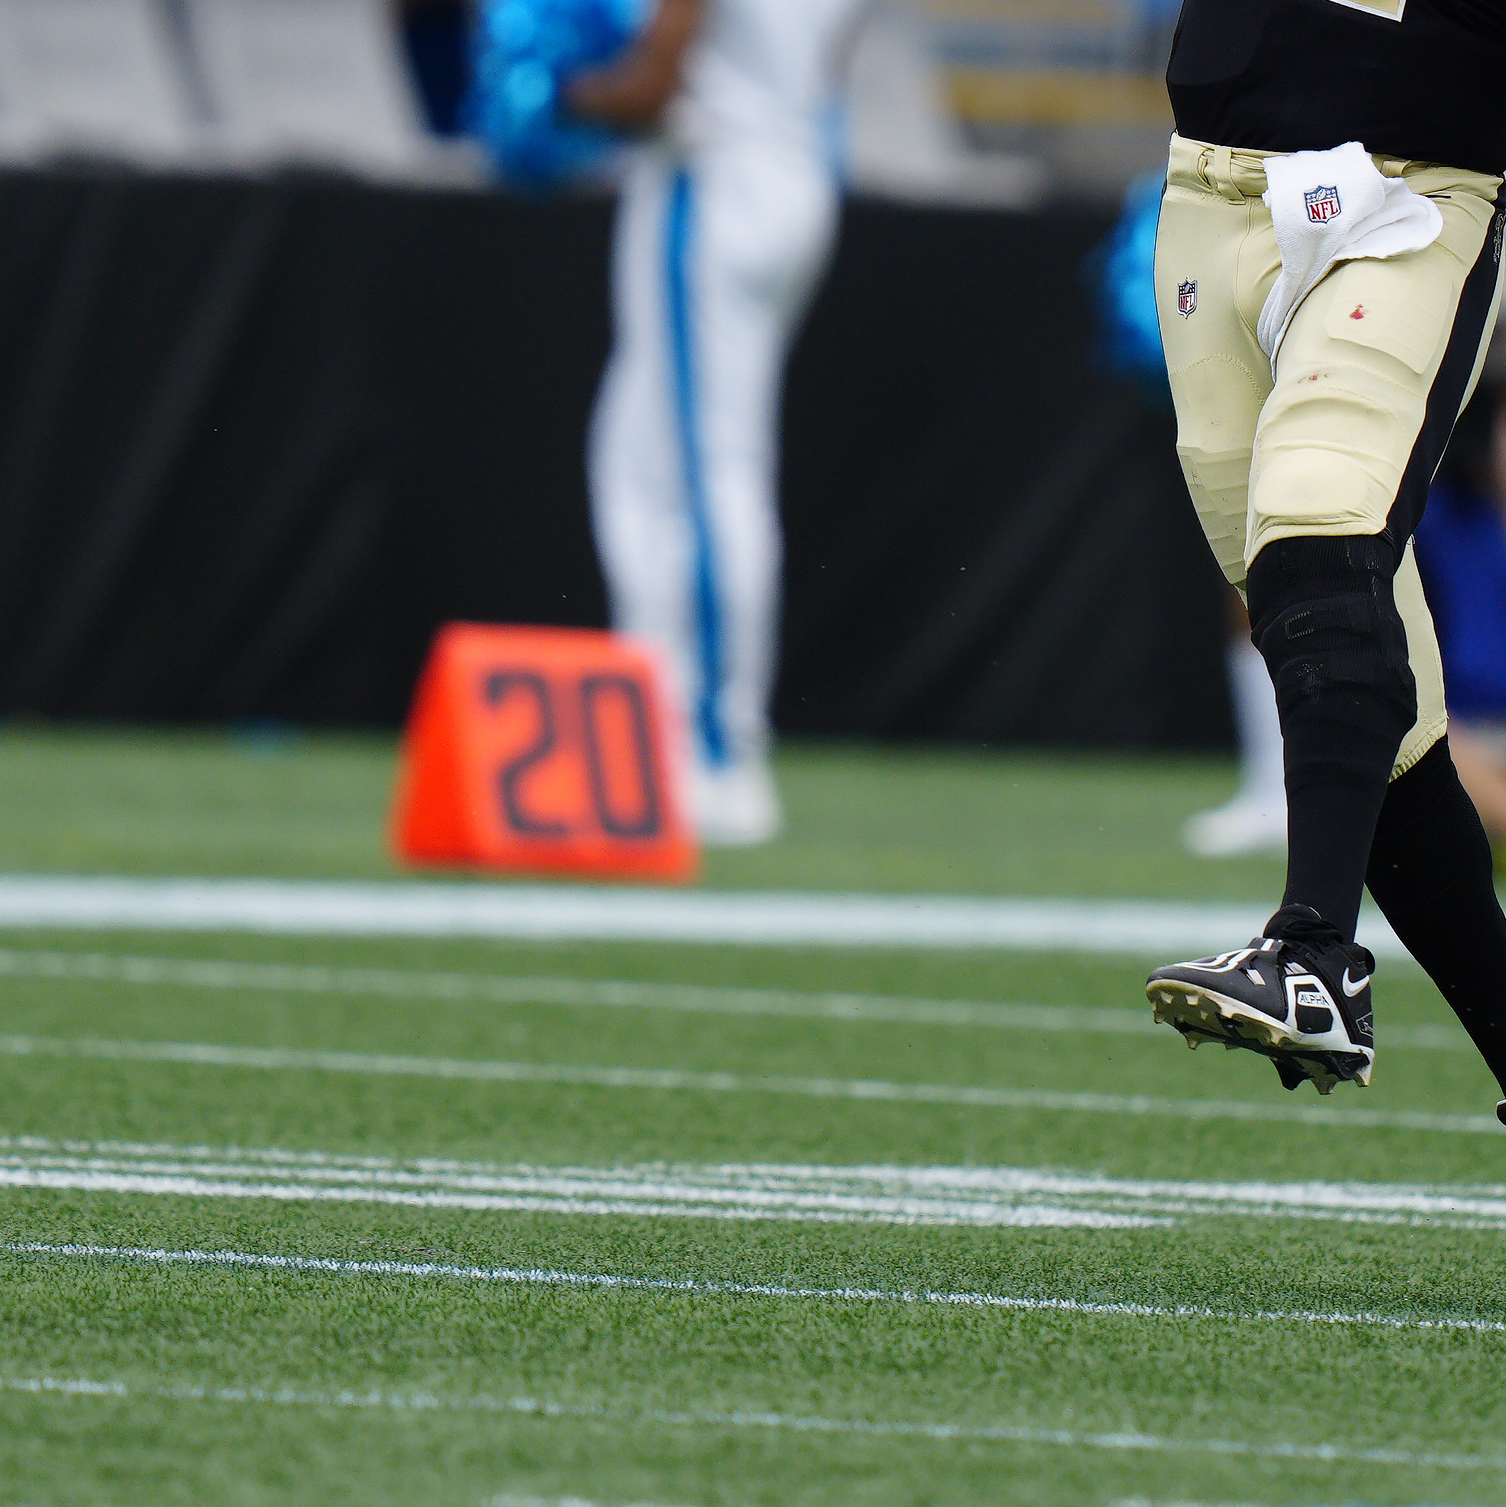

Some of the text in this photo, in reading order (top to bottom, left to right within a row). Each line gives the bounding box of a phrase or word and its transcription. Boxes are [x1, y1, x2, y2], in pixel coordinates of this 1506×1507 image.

[1309, 200, 1339, 220] NFL
[1180, 294, 1195, 310] NFL
[485, 671, 661, 837] 20
[1300, 994, 1330, 1006] ALPHA
